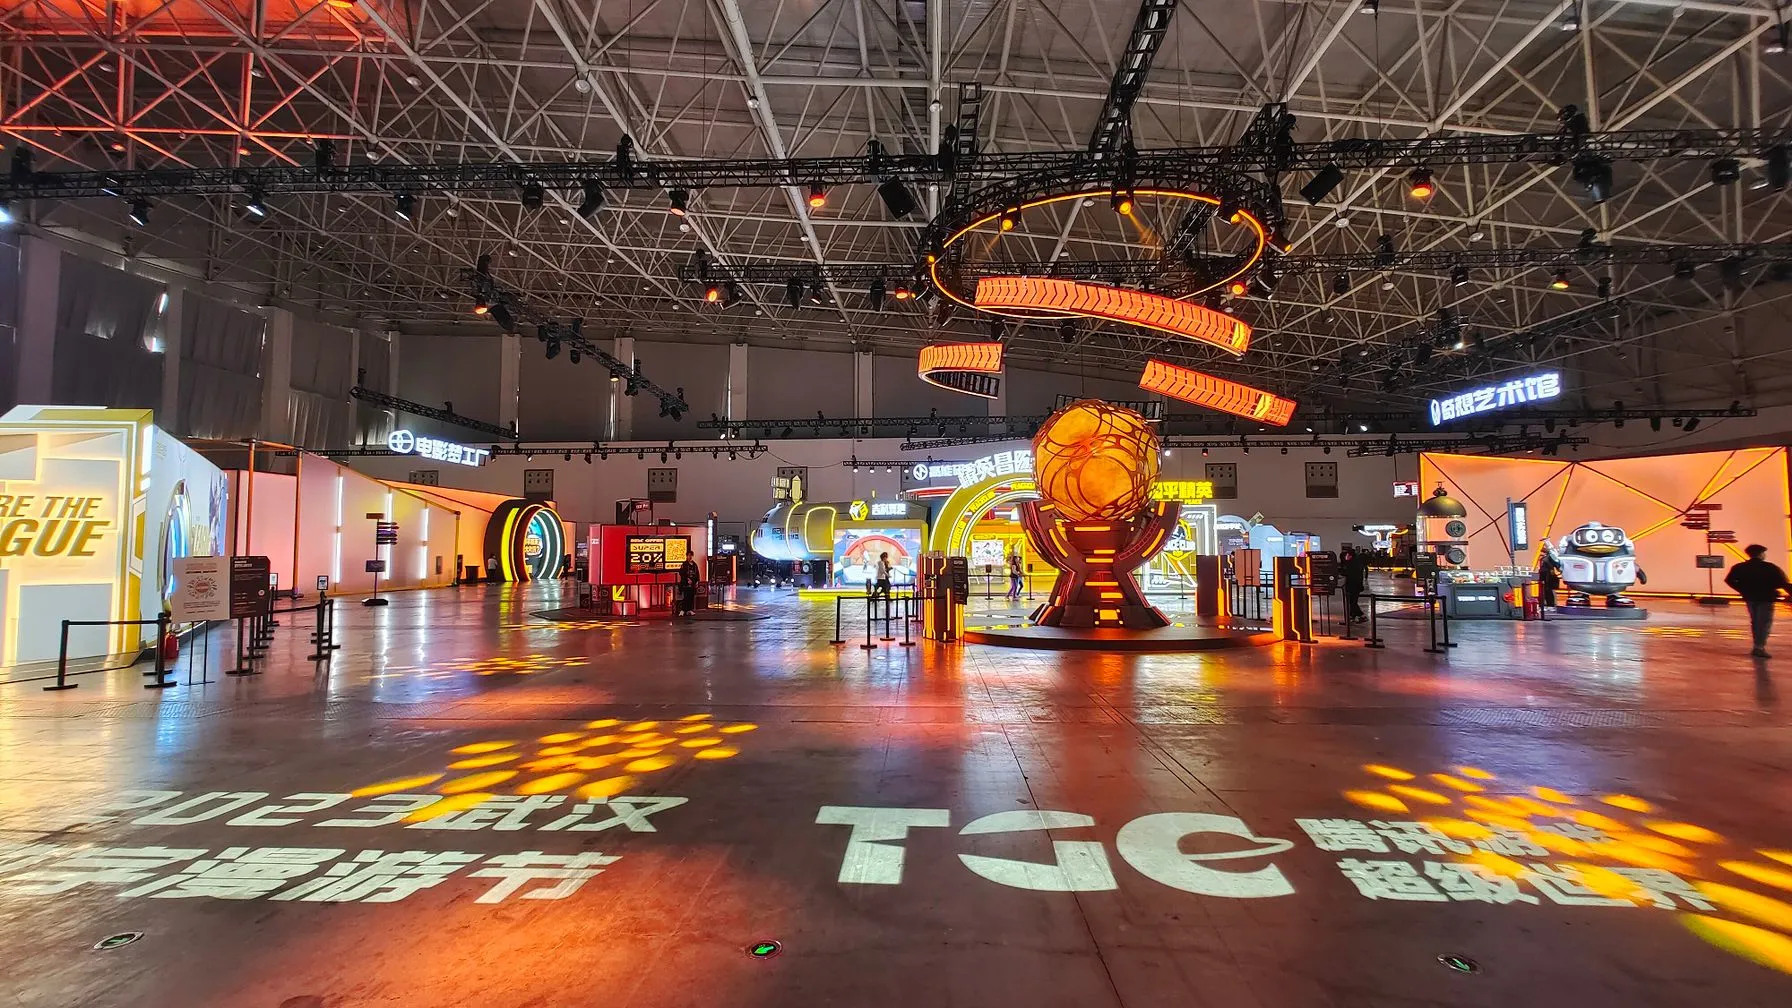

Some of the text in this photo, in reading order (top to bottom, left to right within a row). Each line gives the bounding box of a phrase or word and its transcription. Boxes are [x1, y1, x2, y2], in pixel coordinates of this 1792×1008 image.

[1441, 373, 1560, 421] 奇想艺术馆
[40, 496, 104, 519] THE
[0, 518, 111, 557] GUE
[630, 553, 663, 563] 20%
[42, 790, 689, 833] 2023武汉
[815, 805, 1297, 899] TGC
[1336, 857, 1718, 911] 超级世界
